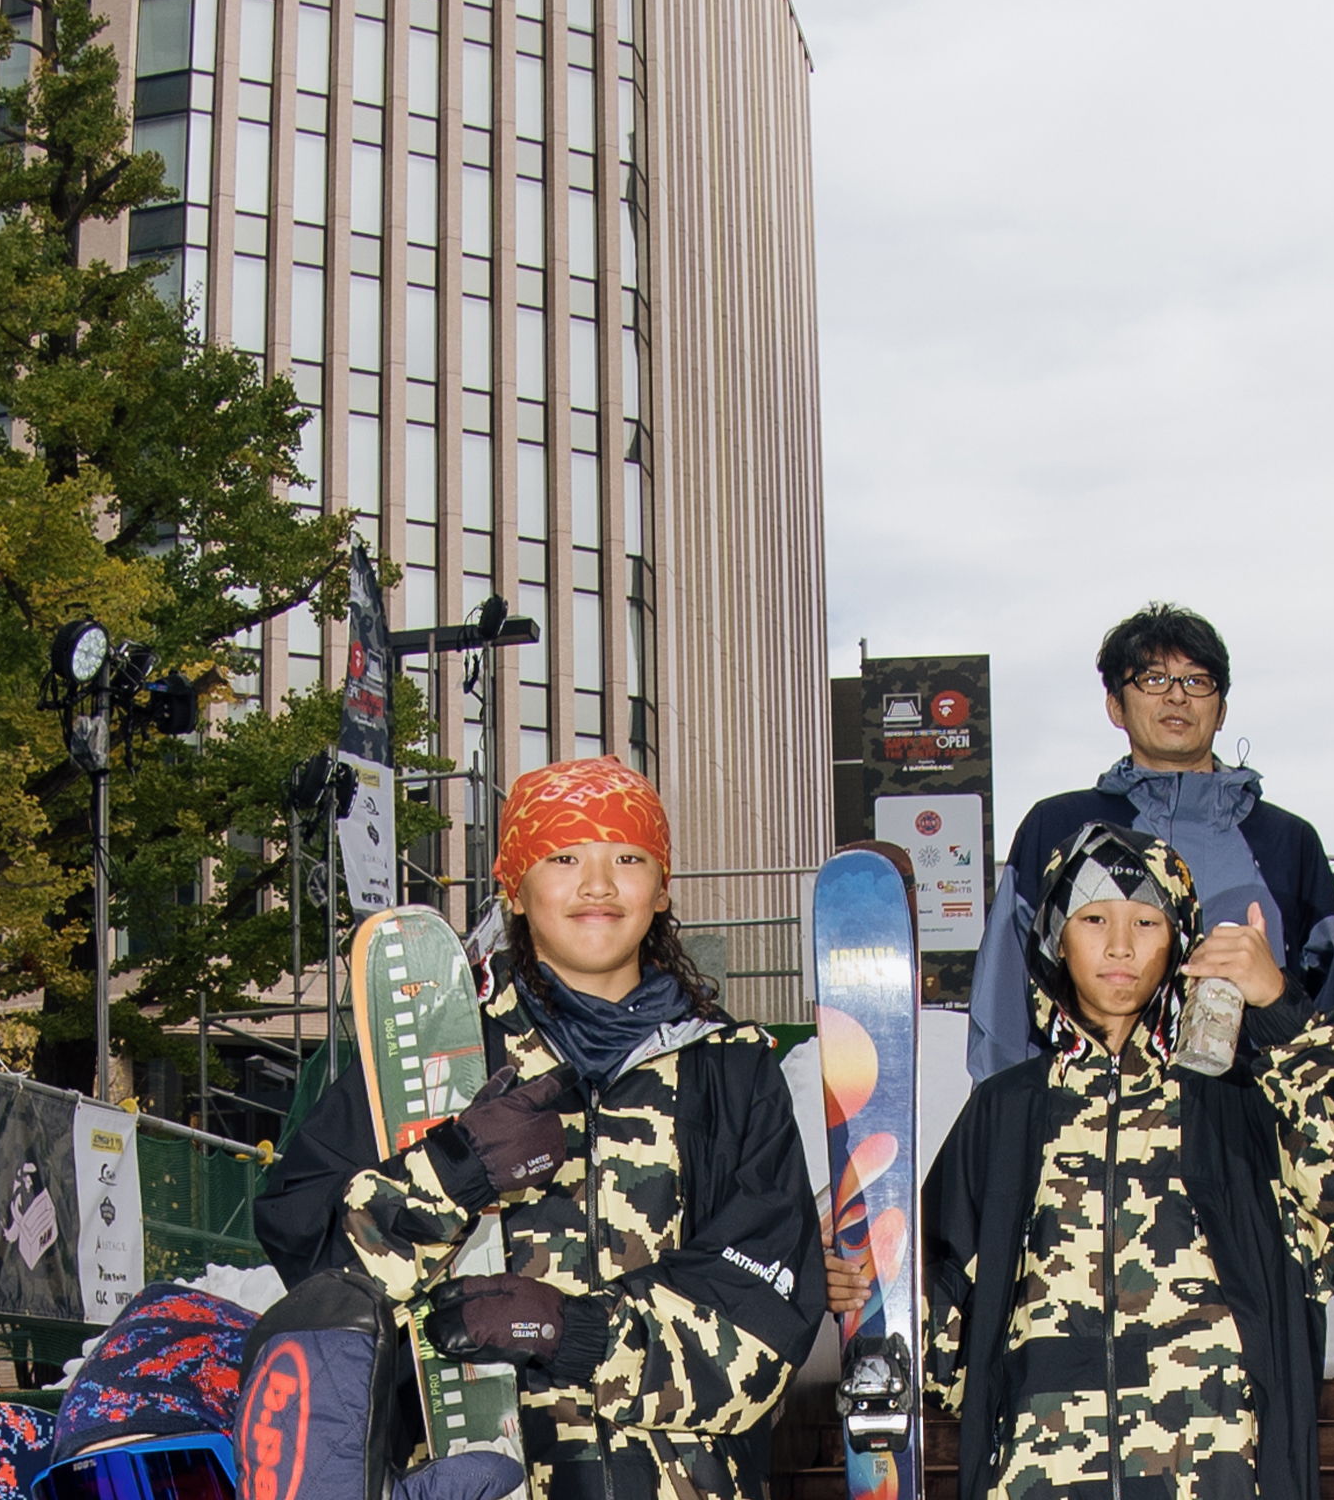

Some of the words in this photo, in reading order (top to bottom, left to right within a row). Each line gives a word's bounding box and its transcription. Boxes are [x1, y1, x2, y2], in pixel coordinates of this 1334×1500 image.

[935, 735, 970, 749] OPEN
[384, 1017, 396, 1041] PRO
[388, 1041, 399, 1057] TW
[527, 1153, 551, 1167] UNITED
[528, 1160, 554, 1176] MOTION
[721, 1246, 777, 1283] BATHING
[430, 1373, 441, 1397] PRO
[433, 1397, 443, 1415] TW
